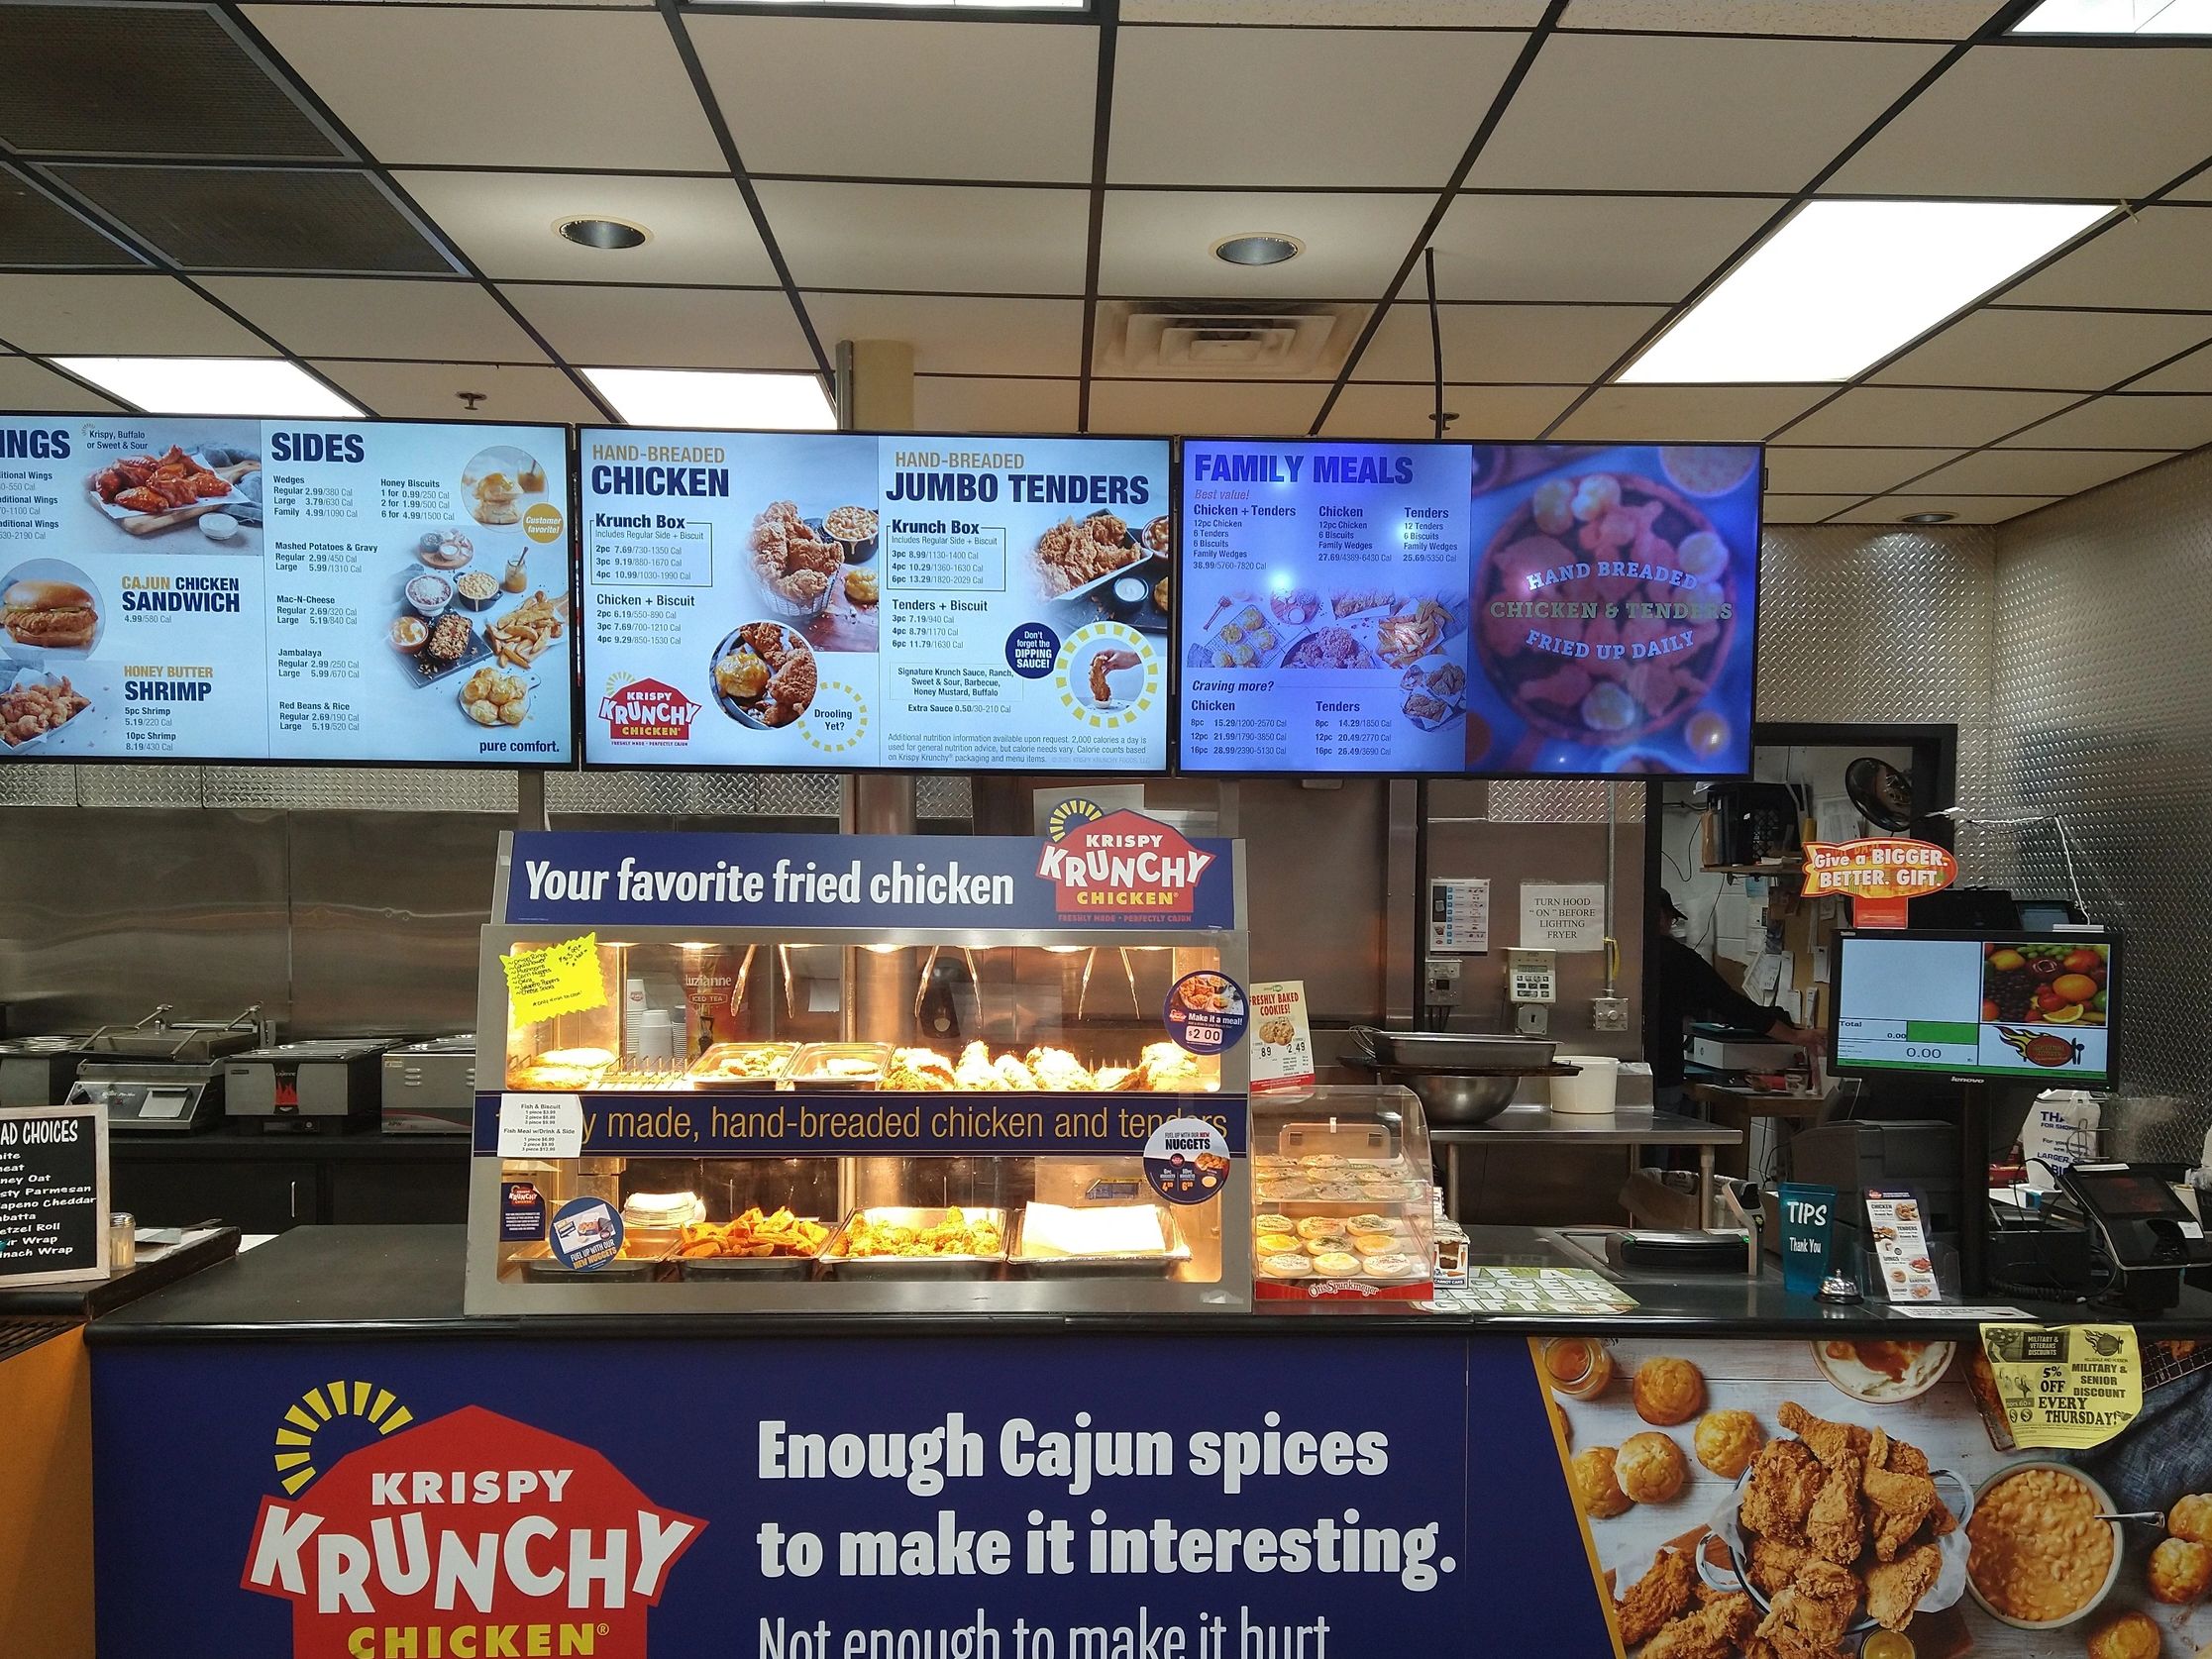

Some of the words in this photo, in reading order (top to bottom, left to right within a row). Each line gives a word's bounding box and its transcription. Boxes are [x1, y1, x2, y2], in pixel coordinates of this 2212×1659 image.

[89, 430, 115, 440] Krispy,
[97, 441, 120, 450] Sweet
[271, 432, 365, 464] SIDES
[593, 445, 725, 463] HAND-BREADED
[895, 452, 1024, 468] HAND-BREADED
[1195, 455, 1304, 483] FAMILY
[1314, 457, 1413, 484] MEALS
[273, 475, 305, 484] Wedges
[380, 478, 405, 488] Honey
[592, 466, 728, 496] CHICKEN
[887, 472, 998, 502] JUMBO
[1008, 474, 1148, 504] TENDERS
[1194, 504, 1238, 516] Chicken
[1241, 507, 1248, 516] +
[1251, 505, 1296, 517] Tenders
[1318, 506, 1363, 517] Chicken
[1405, 507, 1449, 519] Tenders
[595, 513, 651, 528] Krunch
[657, 515, 685, 529] Box
[892, 519, 945, 534] Krunch
[952, 521, 979, 534] Box
[355, 544, 377, 553] Gravy
[1527, 563, 1591, 590] HAND
[1597, 562, 1698, 590] BREADED
[122, 576, 170, 589] CAJUN
[175, 577, 239, 590] CHICKEN
[123, 591, 240, 612] SANDWICH
[596, 594, 641, 605] Chicken
[657, 595, 694, 607] Biscuit
[893, 600, 935, 611] Tenders
[939, 602, 947, 611] +
[951, 600, 988, 611] Biscuit
[1490, 602, 1598, 619] CHICKEN
[1605, 603, 1619, 618] &
[1626, 603, 1733, 620] TENDERS
[1017, 640, 1037, 649] forget
[1526, 630, 1589, 659] FRIED
[1597, 645, 1626, 660] UP
[1633, 630, 1694, 659] DAILY
[278, 649, 322, 658] Jambalaya
[1015, 650, 1052, 659] DIPPING
[1016, 659, 1050, 669] SAUCE!
[125, 666, 161, 677] HONEY
[167, 667, 213, 677] BUTTER
[125, 681, 211, 701] SHRIMP
[1192, 680, 1235, 692] Craving
[1238, 680, 1274, 691] more?
[627, 692, 672, 701] KRISPY
[599, 698, 701, 725] KRUNCHY
[1191, 700, 1235, 711] Chicken
[1316, 701, 1360, 712] Tenders
[814, 709, 852, 720] Drooling
[479, 742, 506, 753] pure
[510, 741, 560, 752] comfort.
[1086, 835, 1163, 847] KRISPY
[1814, 854, 1850, 869] Give
[1855, 855, 1865, 865] a
[1872, 849, 1949, 867] BIGGER.
[1039, 845, 1211, 888] KRUNCHY
[525, 861, 609, 900] Your
[617, 857, 764, 902] favorite
[773, 859, 861, 903] fried
[870, 861, 1014, 905] chicken
[1820, 871, 1890, 887] BETTER.
[1897, 871, 1942, 886] GIFT.
[1278, 992, 1299, 1002] BAKED
[1260, 1004, 1291, 1016] COOKIES!
[1189, 1012, 1209, 1021] Make
[1906, 1047, 1941, 1059] 0.00
[607, 1106, 698, 1142] made,
[711, 1106, 919, 1138] hand-breaded
[931, 1106, 1043, 1138] chicken
[1054, 1106, 1107, 1139] and
[1118, 1107, 1228, 1139] tens
[23, 1120, 78, 1144] CHOICES
[1165, 1139, 1211, 1150] NUGGETS
[26, 1187, 91, 1195] Parmesan
[43, 1196, 96, 1206] Cheddar
[1787, 1201, 1827, 1226] TIPS
[1790, 1237, 1808, 1253] Thank
[1808, 1239, 1821, 1253] You
[2043, 1366, 2061, 1377] 5%
[2072, 1364, 2117, 1373] MILITARY
[2080, 1376, 2117, 1385] SENIOR
[2041, 1381, 2065, 1393] OFF
[2073, 1389, 2126, 1398] DISCOUNT
[2039, 1398, 2087, 1409] EVERY
[2046, 1410, 2117, 1425] THURSDAY!
[759, 1412, 985, 1498] Enough
[1000, 1412, 1173, 1496] Cajun
[1189, 1410, 1389, 1495] spices
[371, 1469, 574, 1505] KRISPY
[757, 1522, 823, 1578] to
[839, 1509, 1010, 1576] make
[1026, 1509, 1074, 1576] it
[1091, 1507, 1456, 1593] interesting.
[250, 1504, 694, 1613] KRUNCHY
[759, 1616, 830, 1659] Not
[1012, 1618, 1055, 1659] to
[1070, 1606, 1186, 1659] make
[1200, 1611, 1227, 1659] it
[1240, 1606, 1329, 1659] hurt
